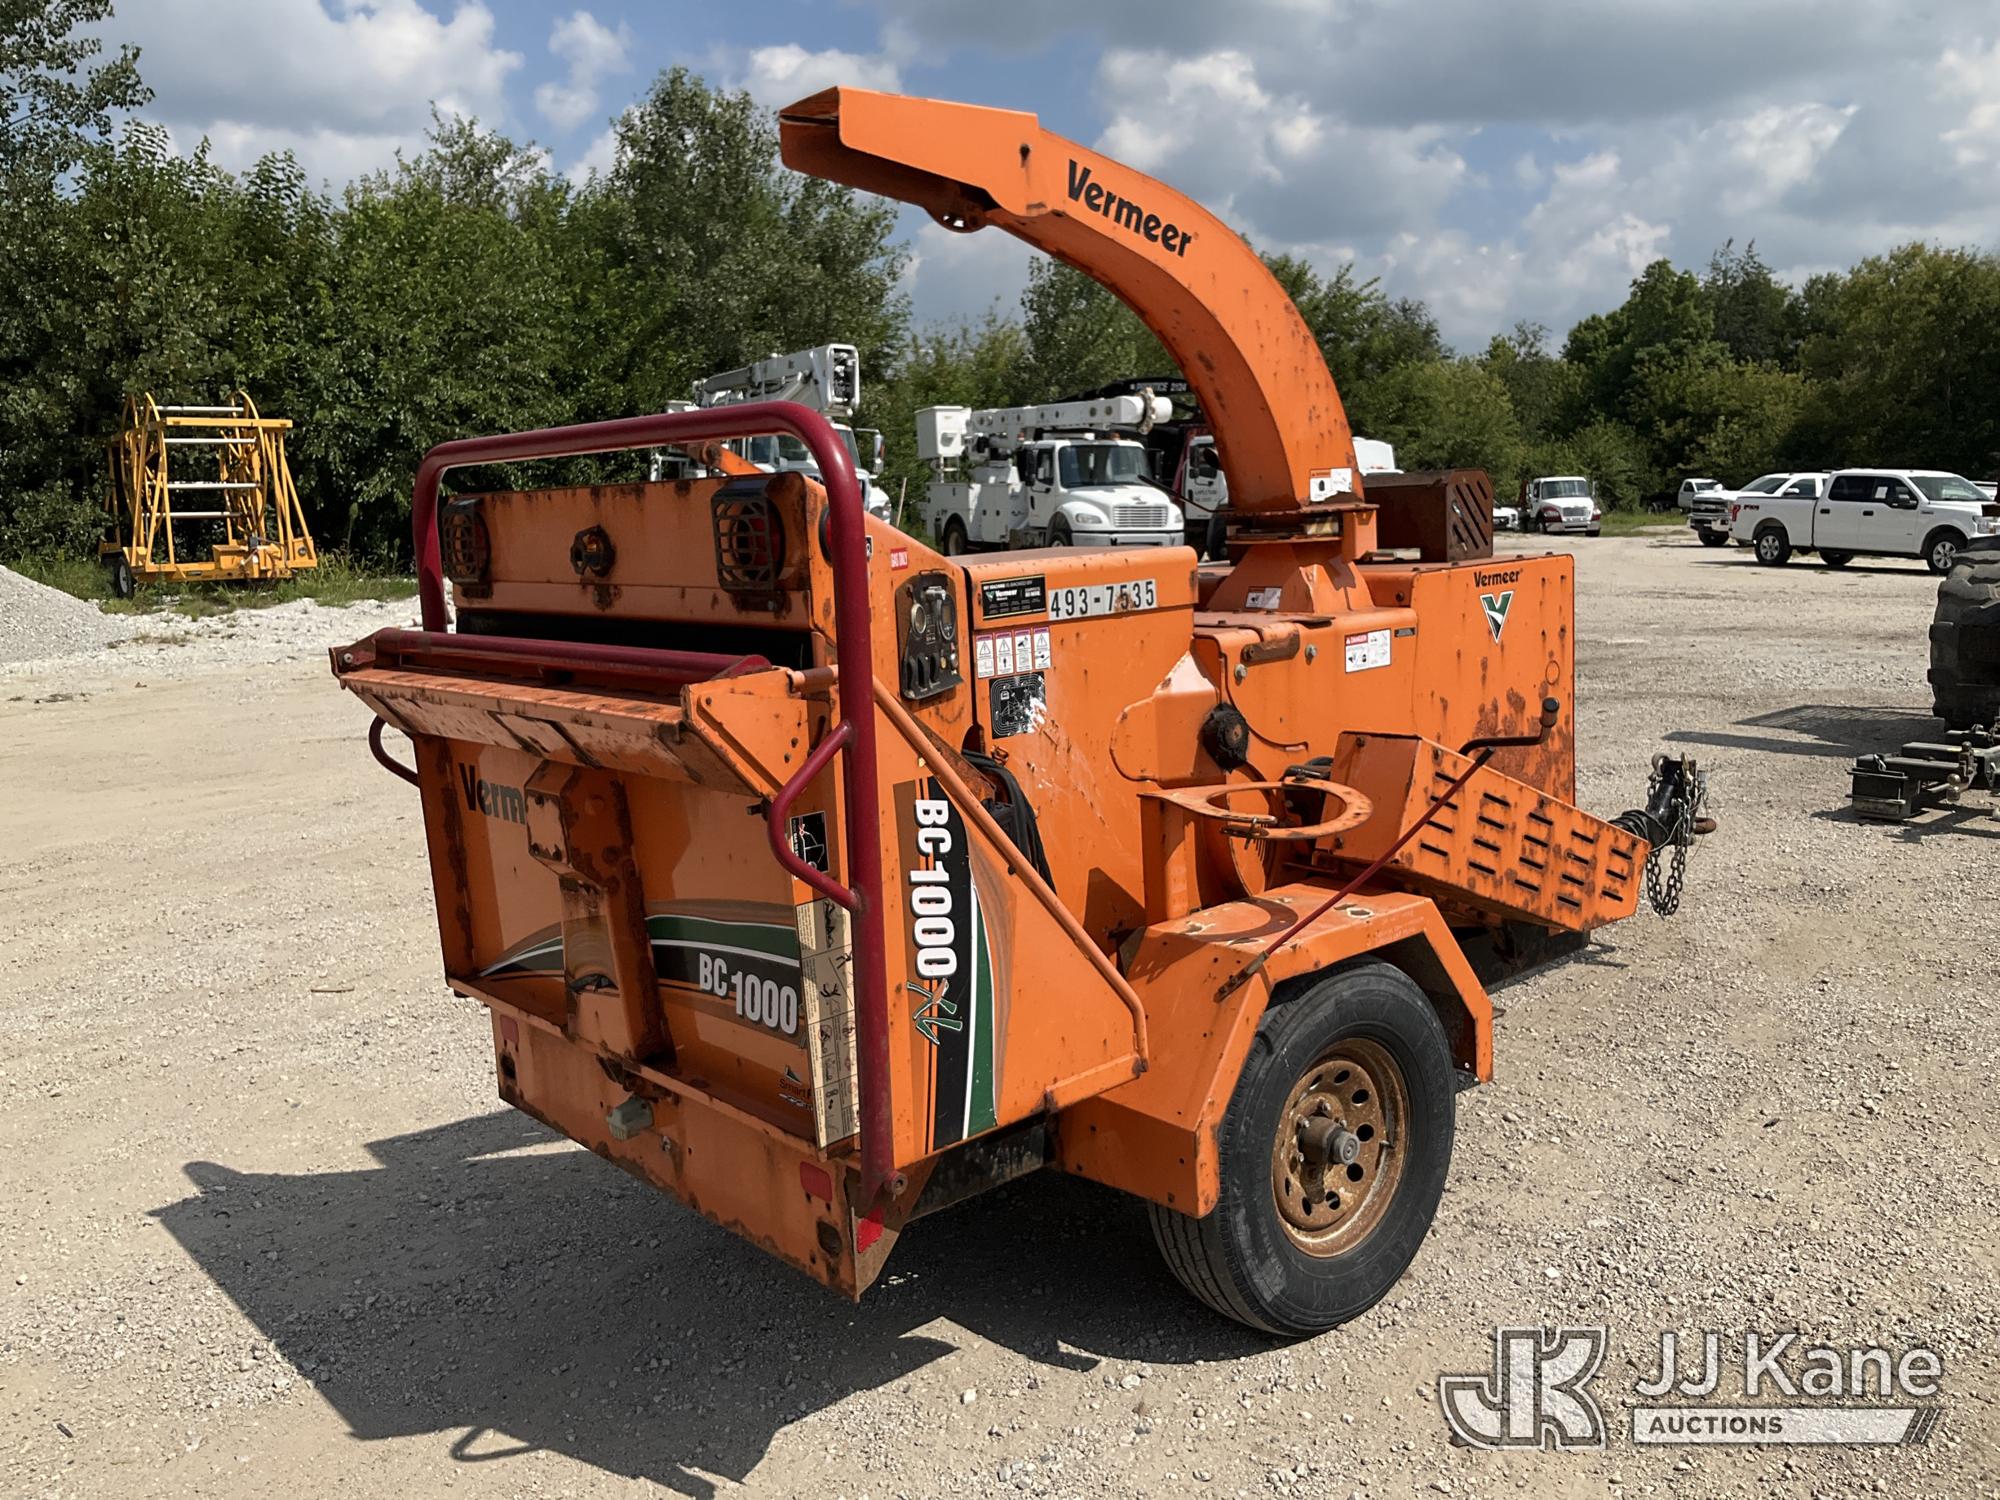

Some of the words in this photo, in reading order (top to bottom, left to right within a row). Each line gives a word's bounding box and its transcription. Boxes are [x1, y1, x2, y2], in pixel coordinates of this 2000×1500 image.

[1068, 158, 1192, 257] Vermeer
[1050, 580, 1154, 618] 493-7535
[1473, 570, 1520, 588] Vermeer
[458, 762, 526, 825] Verm
